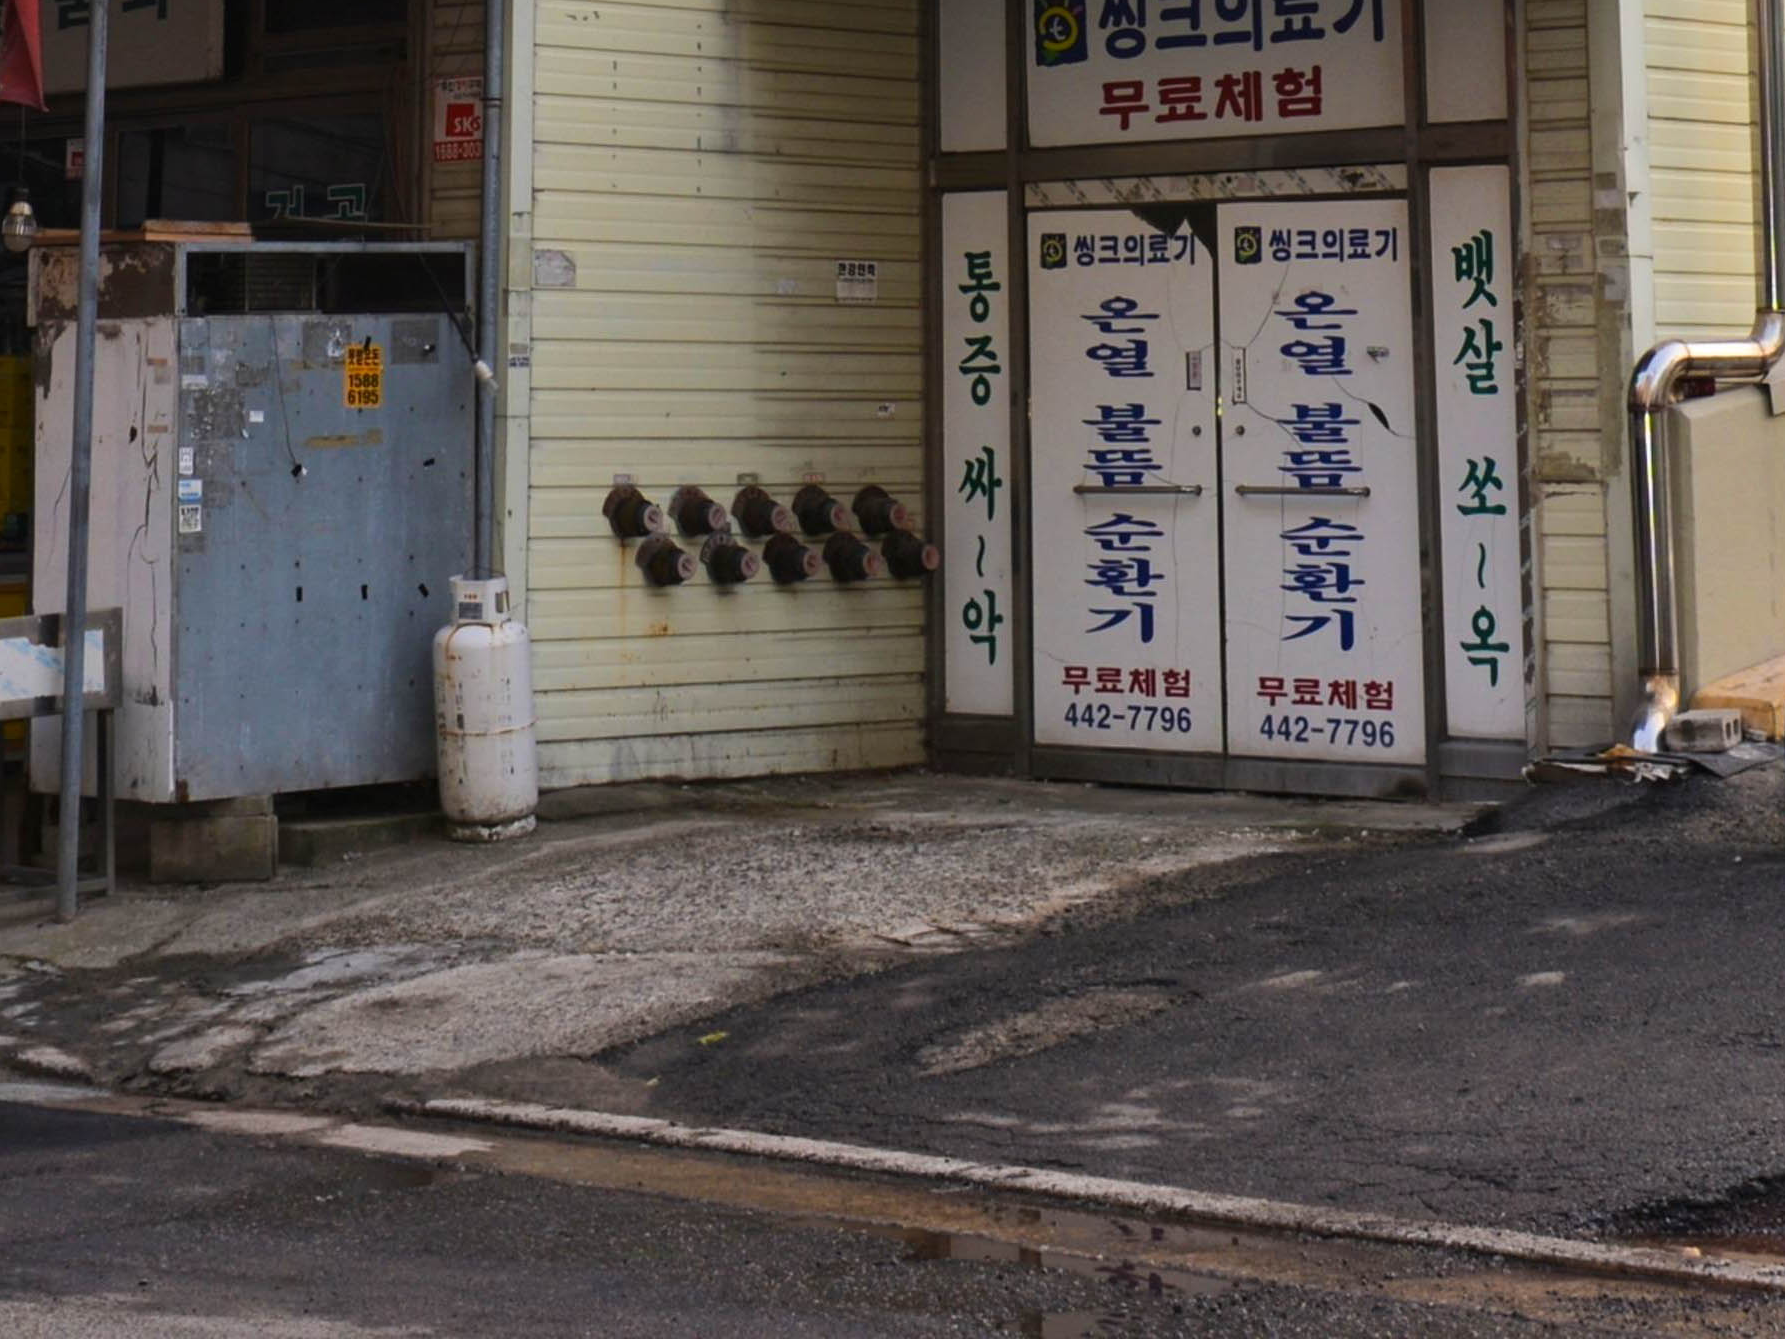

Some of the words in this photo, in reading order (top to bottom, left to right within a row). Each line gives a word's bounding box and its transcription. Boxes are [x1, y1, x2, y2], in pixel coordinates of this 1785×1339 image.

[1099, 64, 1323, 131] 무료체험
[1073, 232, 1196, 266] 씽크의료기
[1268, 227, 1399, 263] 씽크의료기
[958, 250, 1002, 407] 통증
[1081, 296, 1160, 378] 온열
[1274, 291, 1359, 376] 온열
[1451, 228, 1504, 396] 뱃살
[347, 389, 379, 405] 6195
[348, 372, 379, 389] 1588
[1081, 402, 1164, 487] 불뜸
[1276, 402, 1363, 489] 불뜸
[1083, 512, 1165, 644] 순환기
[1279, 515, 1366, 652] 순환기
[1062, 666, 1192, 698] 무료체험
[1256, 676, 1395, 711] 무료체험
[1064, 703, 1192, 734] 442-7796
[1260, 714, 1395, 748] 442-7796
